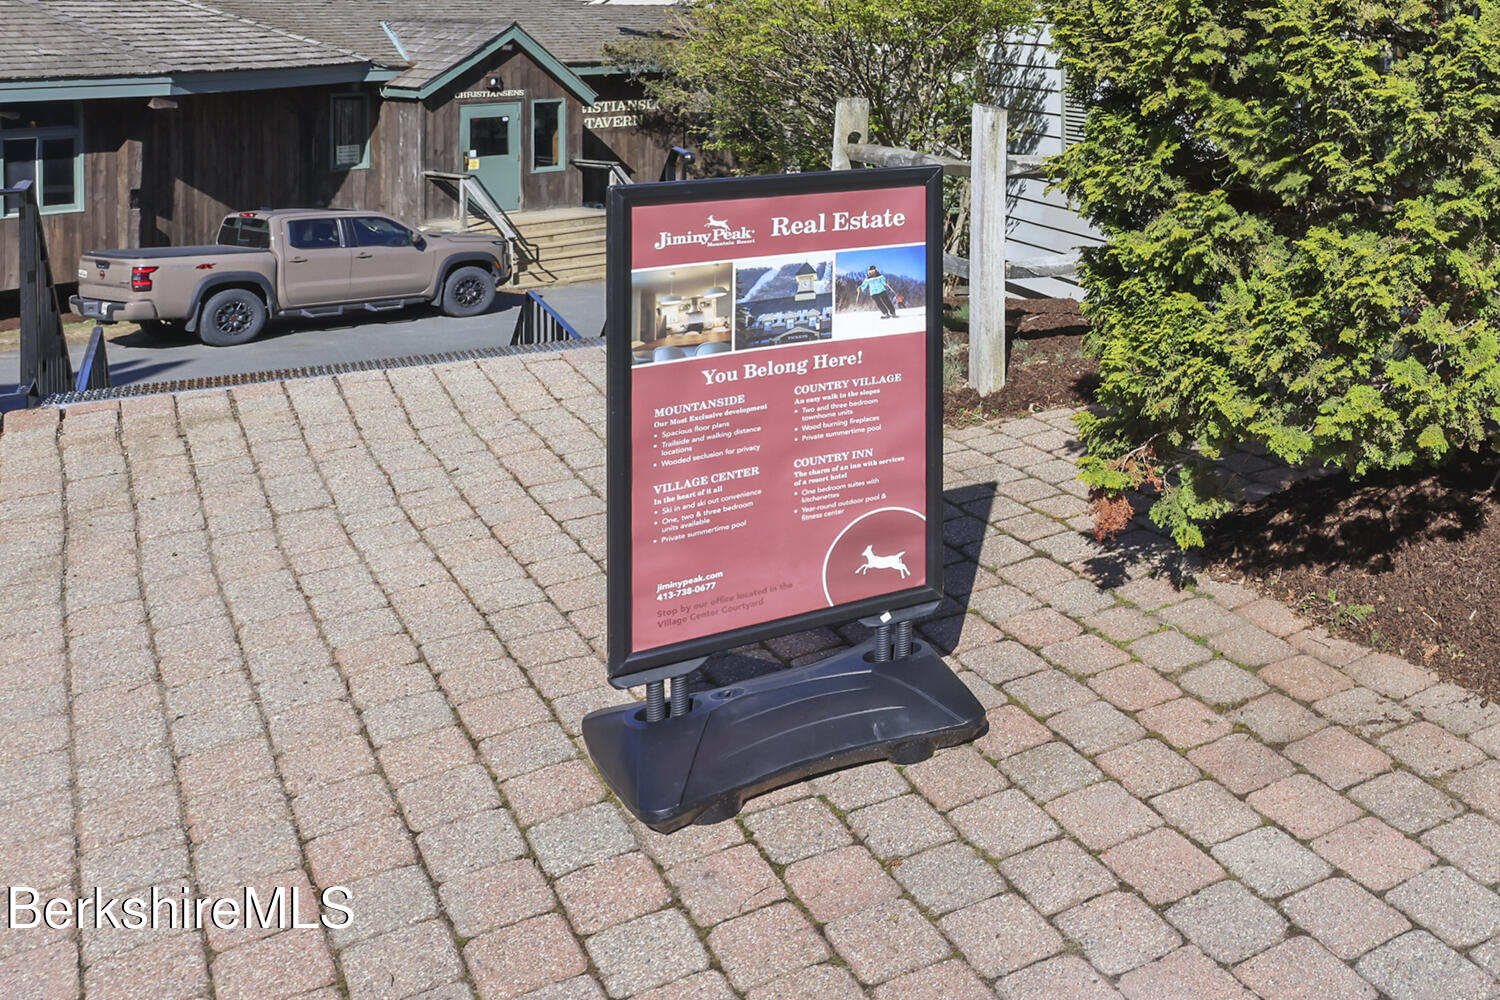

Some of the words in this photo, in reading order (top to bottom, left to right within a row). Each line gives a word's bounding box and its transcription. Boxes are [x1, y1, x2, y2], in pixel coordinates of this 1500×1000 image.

[584, 115, 643, 128] TAVERN
[771, 212, 826, 237] Real
[832, 208, 906, 231] Estate
[654, 231, 711, 250] Jiminy
[712, 227, 752, 242] Peak
[702, 368, 738, 385] You
[743, 359, 808, 375] Belong
[813, 350, 863, 370] Here!
[794, 380, 849, 395] COUNTRY
[852, 373, 902, 386] VILLAGE
[860, 388, 880, 396] slopes
[654, 394, 745, 418] MOUNTANSIDE
[849, 398, 878, 407] bedroom
[670, 418, 687, 426] Most
[690, 412, 722, 422] Exclusive
[724, 404, 768, 416] development
[802, 411, 836, 421] townhome
[802, 422, 821, 431] Wood
[822, 419, 848, 428] burning
[849, 416, 880, 425] fireplaces
[662, 426, 692, 438] Spacious
[712, 422, 730, 430] plans
[662, 438, 689, 448] Trailside
[692, 435, 705, 443] and
[706, 431, 732, 440] walking
[734, 426, 761, 435] distance
[802, 433, 824, 441] Private
[826, 427, 865, 438] summertime
[867, 424, 881, 432] pool
[661, 456, 691, 466] Wooded
[693, 451, 724, 461] seclusion
[737, 445, 760, 454] privacy
[662, 446, 692, 456] locations
[794, 452, 849, 468] COUNTRY
[852, 448, 874, 459] INN
[808, 468, 830, 476] charm
[863, 460, 877, 468] with
[879, 456, 905, 465] services
[653, 476, 708, 494] VILLAGE
[711, 466, 760, 483] CENTER
[808, 476, 829, 484] resort
[830, 472, 847, 481] hotel
[676, 492, 696, 501] heart
[817, 483, 846, 493] bedroom
[662, 507, 672, 515] Ski
[682, 502, 696, 510] and
[708, 497, 719, 505] out
[721, 489, 762, 502] convenience
[704, 508, 721, 516] three
[723, 501, 754, 512] bedroom
[838, 498, 864, 506] outdoor
[865, 494, 880, 503] pool
[824, 509, 844, 517] center
[661, 534, 685, 543] Private
[687, 525, 730, 537] summertime
[731, 520, 747, 530] pool
[662, 525, 678, 533] units
[680, 518, 710, 529] available
[656, 571, 723, 593] jiminypeak.com
[657, 582, 716, 600] 413-738-0677
[657, 608, 678, 618] Stop
[680, 604, 690, 613] by
[693, 601, 708, 609] our
[710, 596, 734, 606] office
[736, 588, 768, 600] located
[779, 582, 793, 591] the
[657, 617, 687, 628] Village
[690, 610, 718, 621] Center
[721, 598, 764, 613] Courtyard
